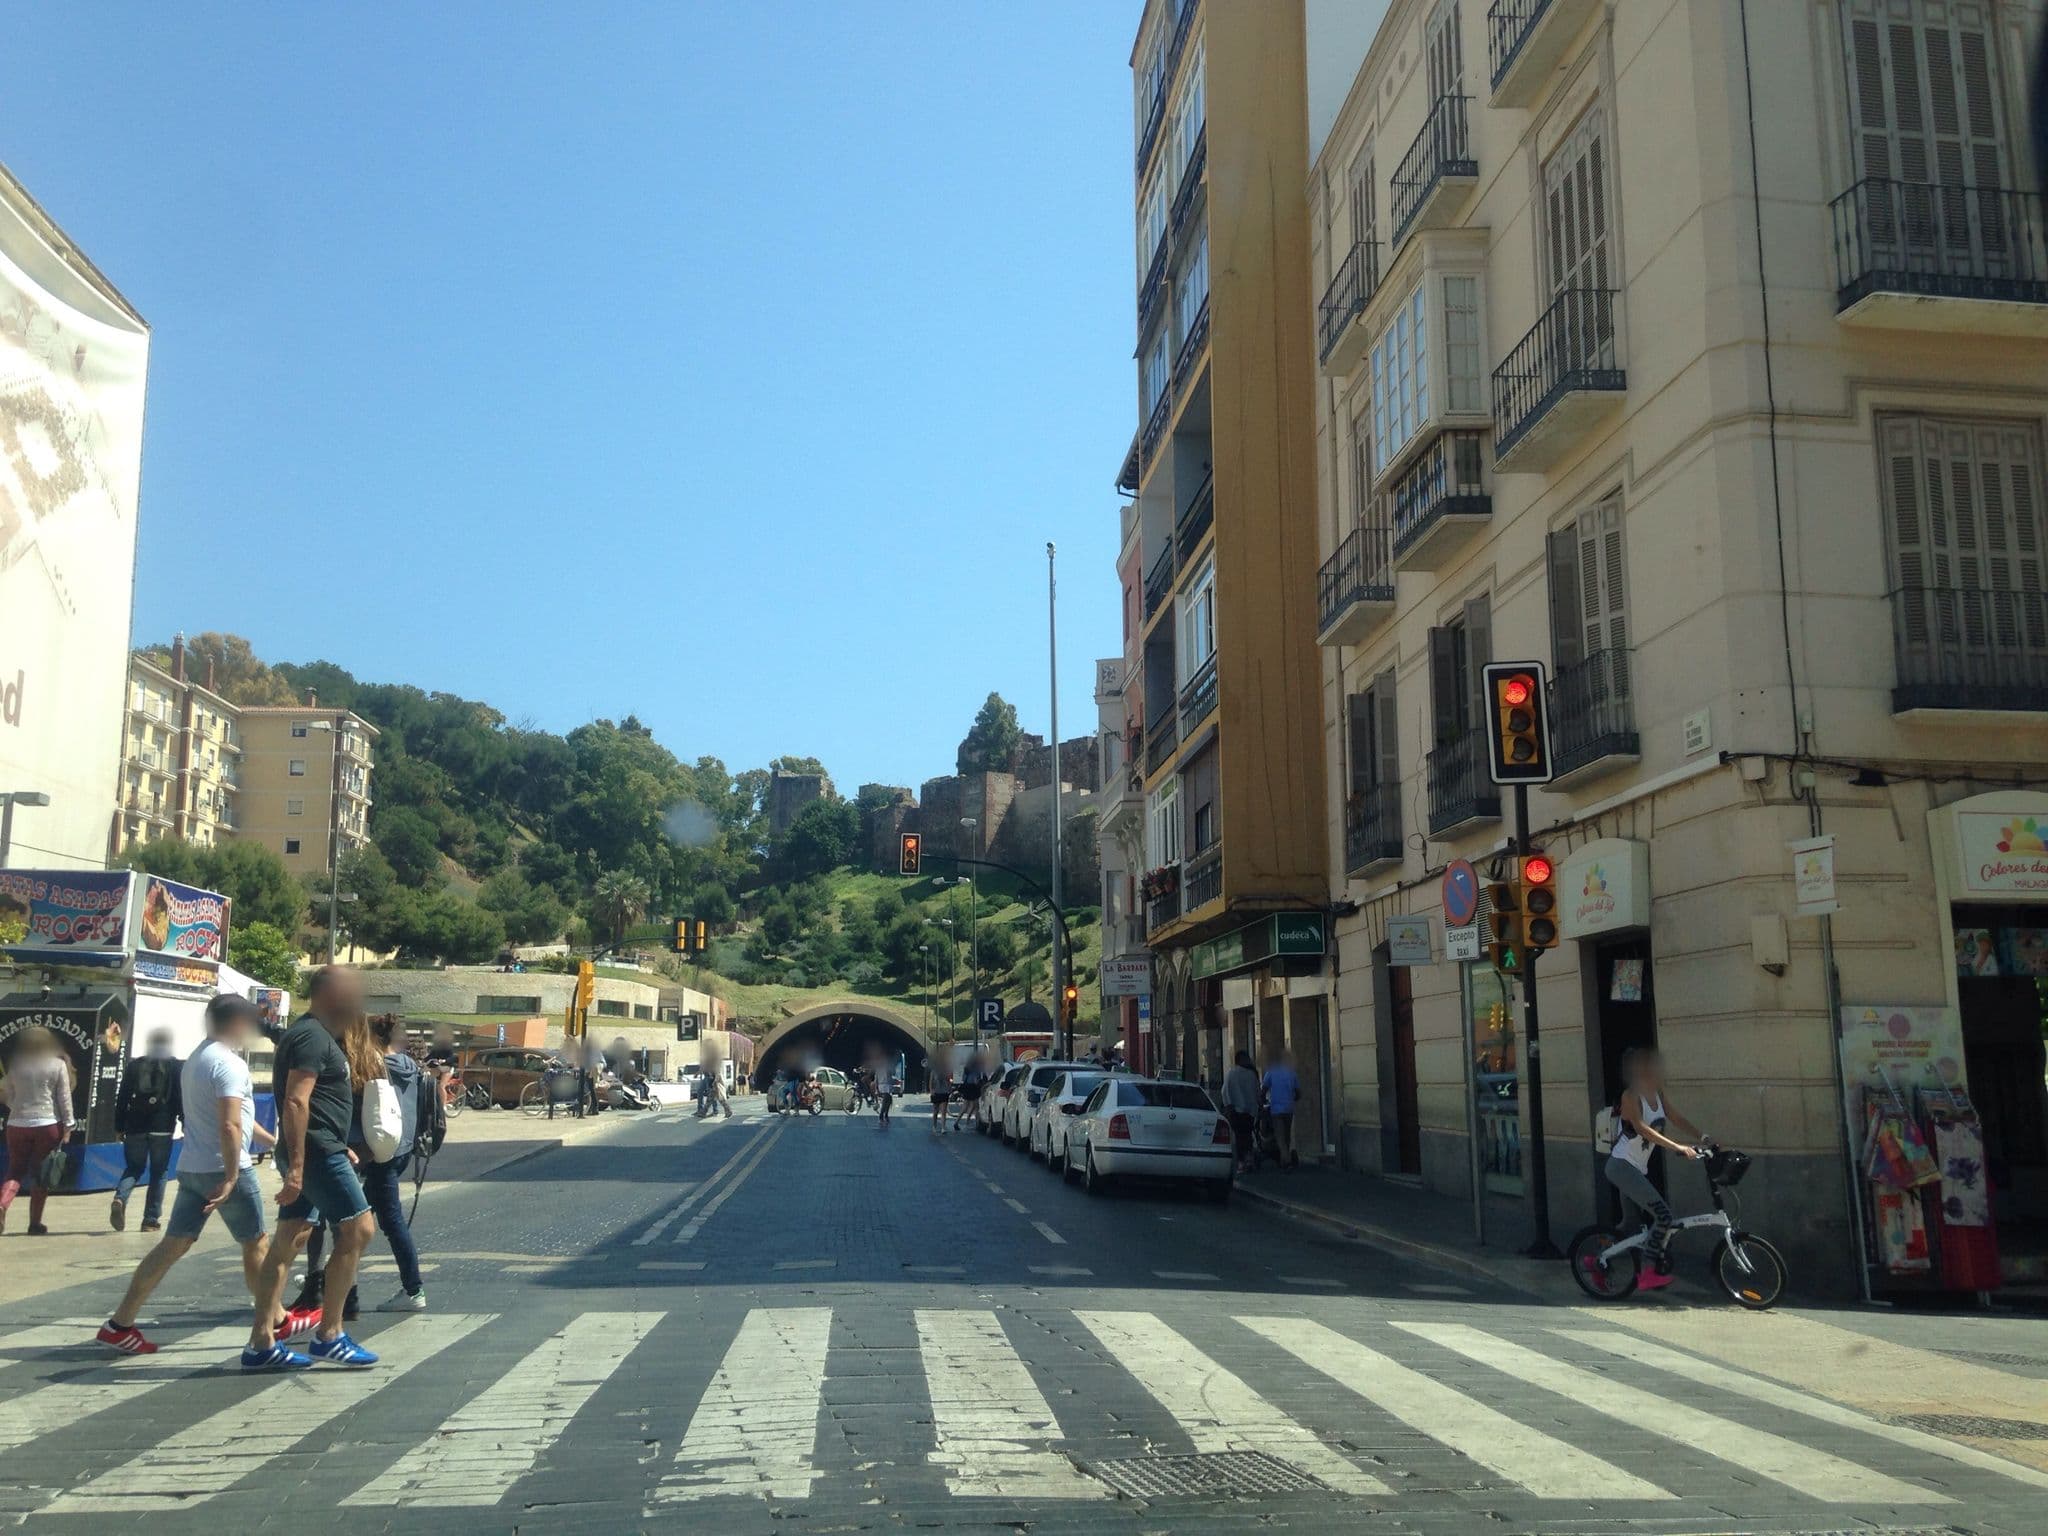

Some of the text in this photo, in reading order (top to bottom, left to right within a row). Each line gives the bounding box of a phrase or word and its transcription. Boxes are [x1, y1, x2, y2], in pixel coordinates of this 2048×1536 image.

[1980, 861, 2027, 882] Colores
[48, 885, 126, 911] ASADAS
[33, 913, 121, 942] ROCKI
[1448, 932, 1475, 943] Excepto
[1457, 947, 1469, 956] taxi
[44, 1014, 93, 1050] ASADAS
[681, 1018, 694, 1034] P
